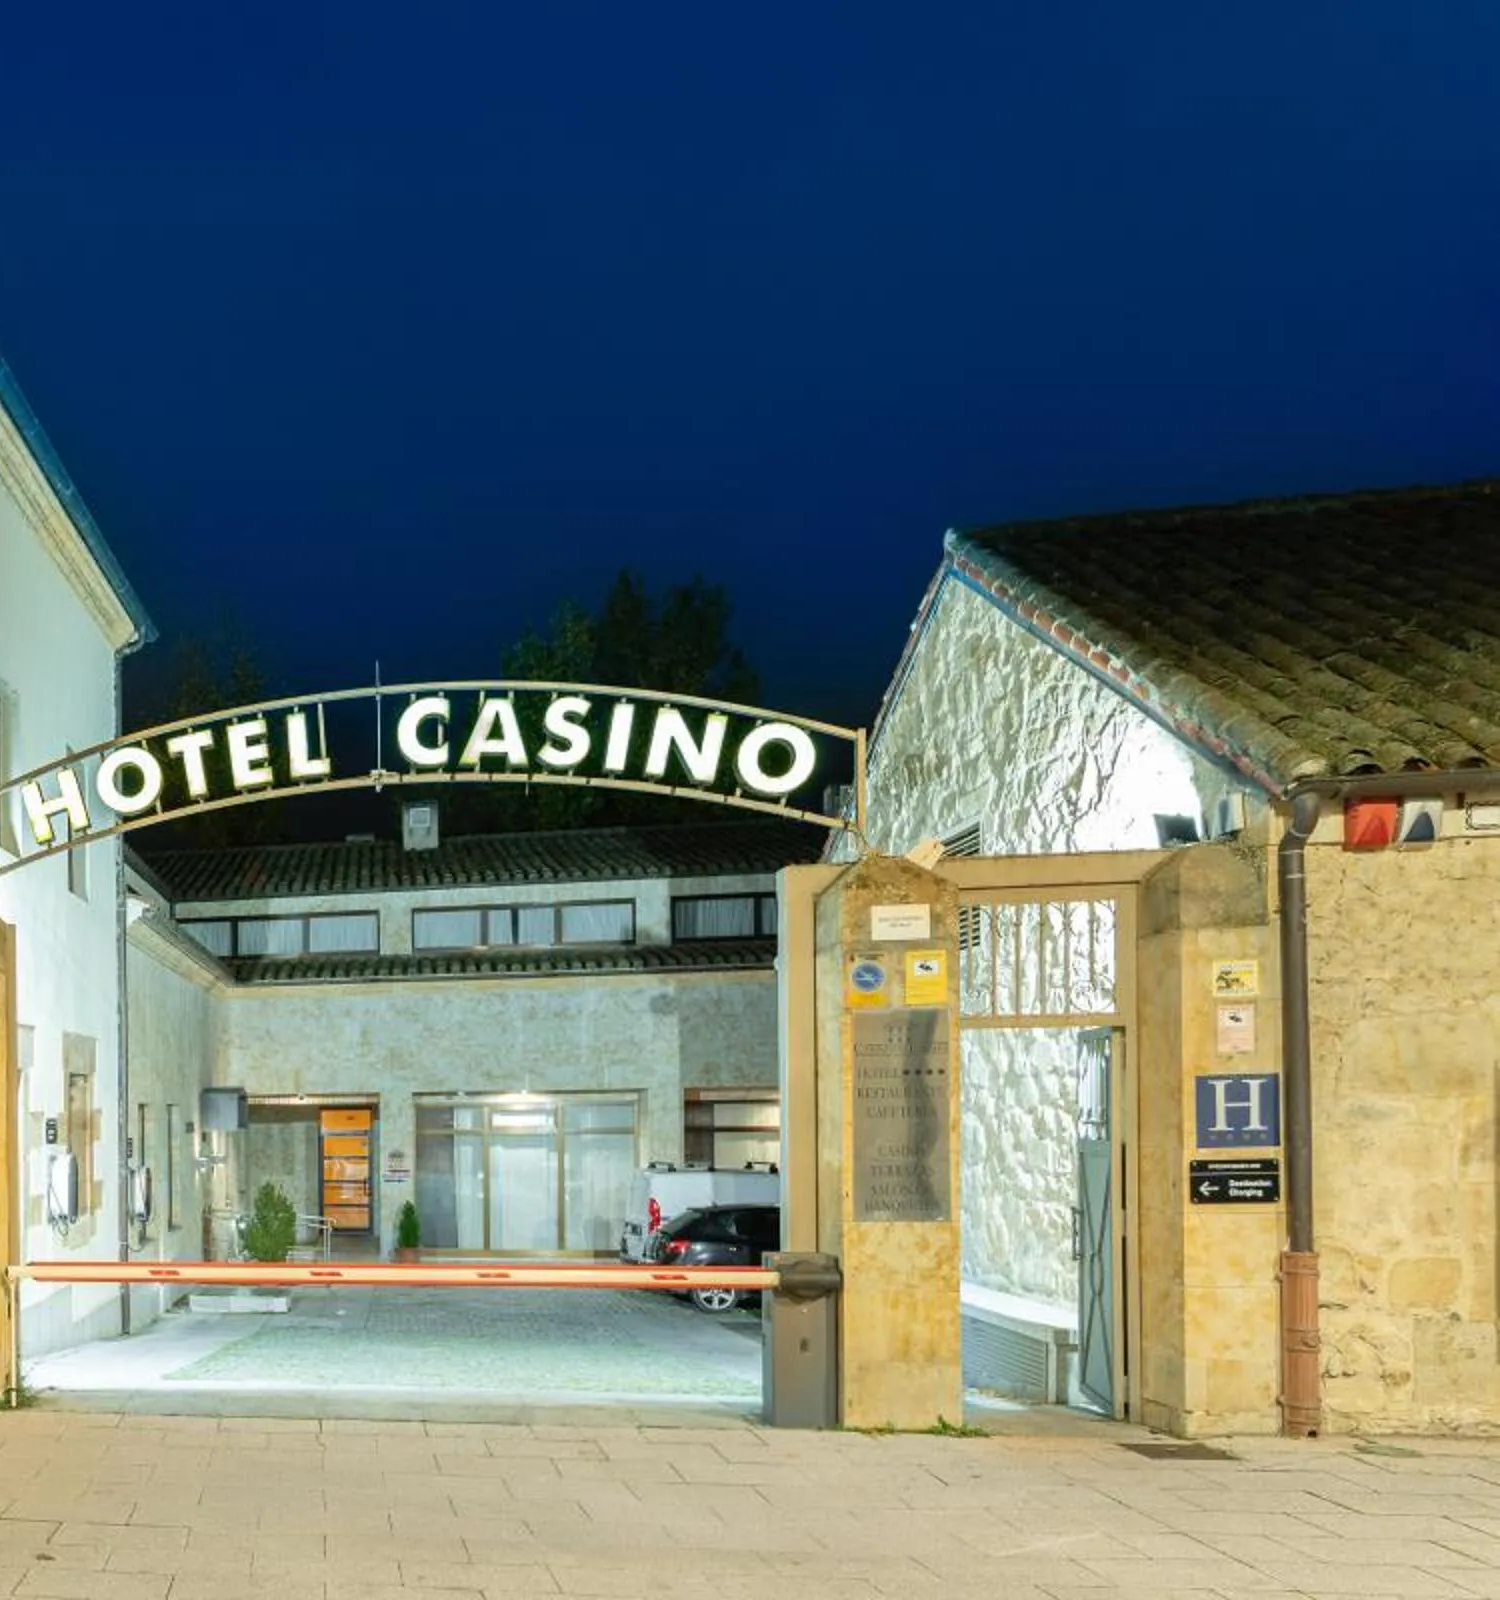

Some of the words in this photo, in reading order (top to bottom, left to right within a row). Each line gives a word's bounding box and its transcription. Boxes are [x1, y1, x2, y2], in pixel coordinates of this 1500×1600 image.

[20, 711, 332, 845] HOTEL
[397, 696, 818, 798] CASINO
[1207, 1079, 1268, 1131] H
